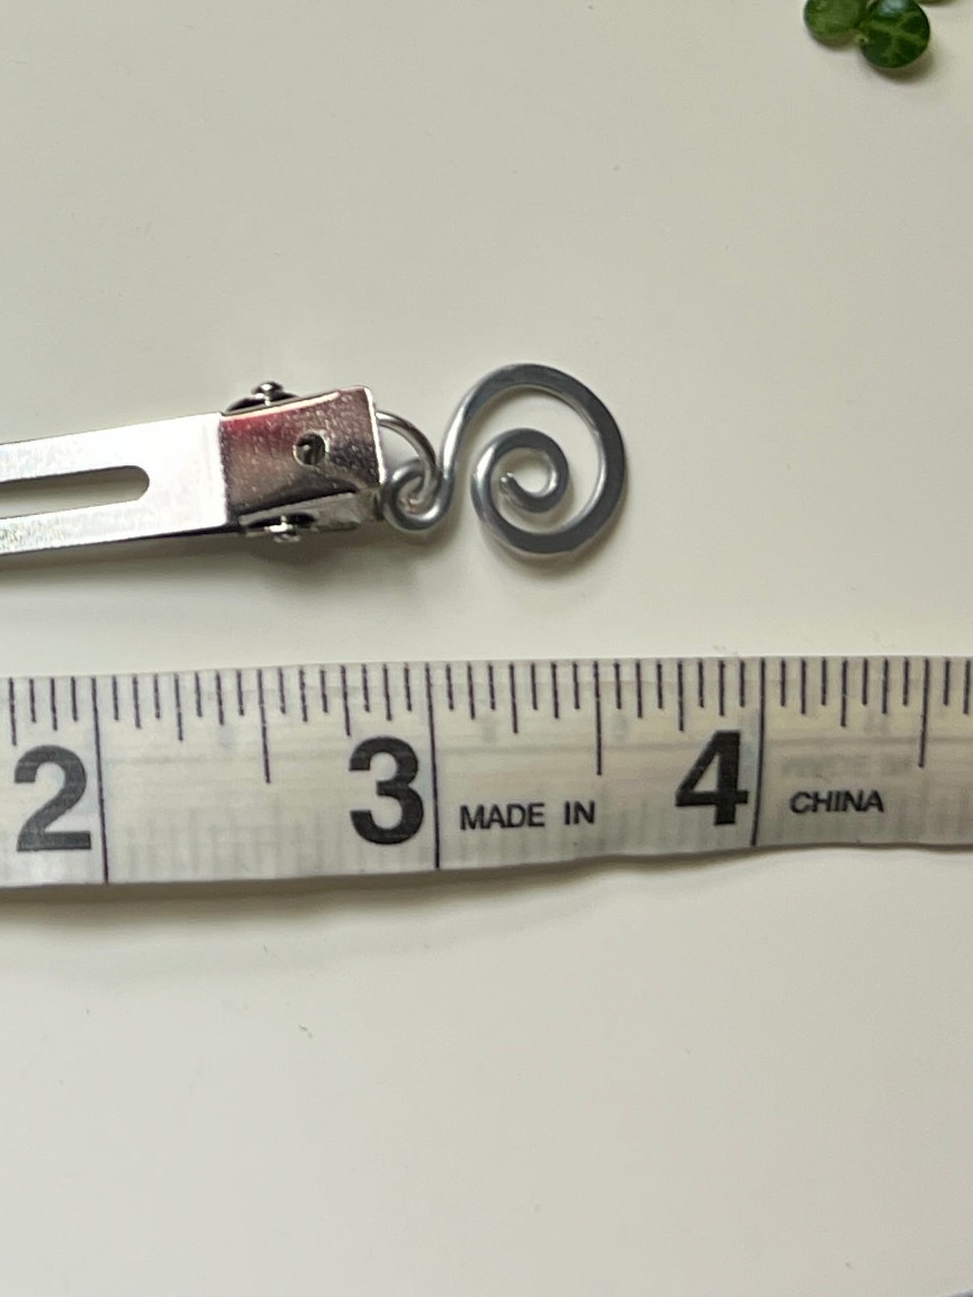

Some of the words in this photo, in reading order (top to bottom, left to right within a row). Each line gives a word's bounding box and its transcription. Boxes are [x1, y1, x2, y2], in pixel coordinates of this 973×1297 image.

[13, 745, 92, 852] 2
[348, 736, 424, 845] 3
[459, 803, 545, 831] MADE
[563, 801, 596, 826] IN
[675, 730, 749, 826] 4
[789, 789, 885, 815] CHINA
